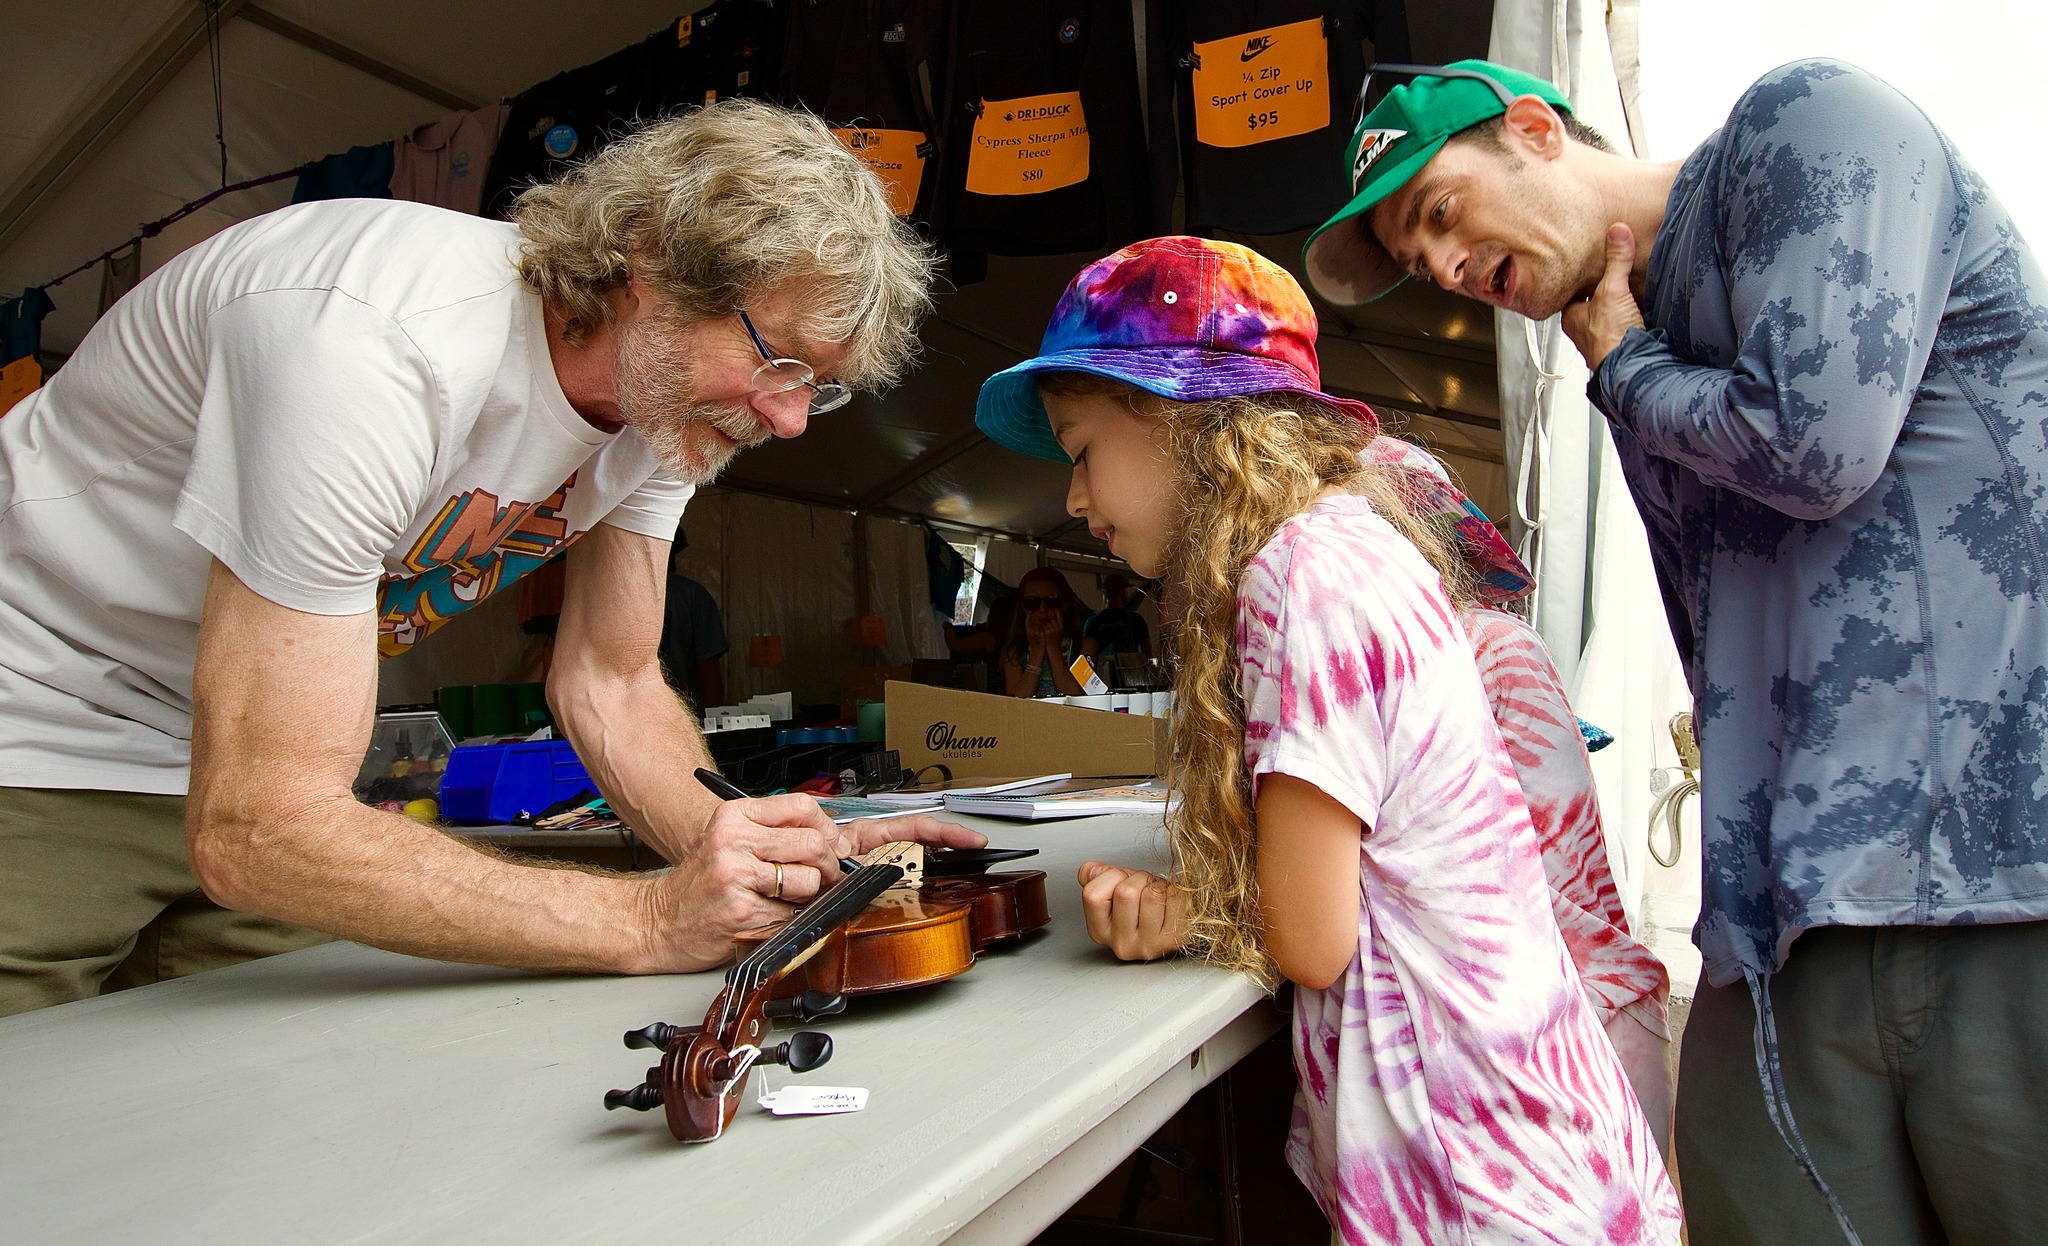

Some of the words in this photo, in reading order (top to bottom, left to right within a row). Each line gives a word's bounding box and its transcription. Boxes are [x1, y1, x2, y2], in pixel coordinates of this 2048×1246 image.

[1245, 35, 1272, 52] NIKE
[1260, 66, 1281, 80] Zip
[1211, 90, 1248, 109] Sport
[1253, 84, 1290, 100] Cover
[1296, 79, 1313, 93] Up
[1248, 110, 1279, 130] $95
[977, 135, 1022, 148] Cypress
[1027, 131, 1066, 146] Sherpa
[1017, 148, 1051, 159] Fleece
[1022, 168, 1043, 182] $80
[925, 721, 999, 751] Ohana
[942, 750, 982, 758] ukuleles
